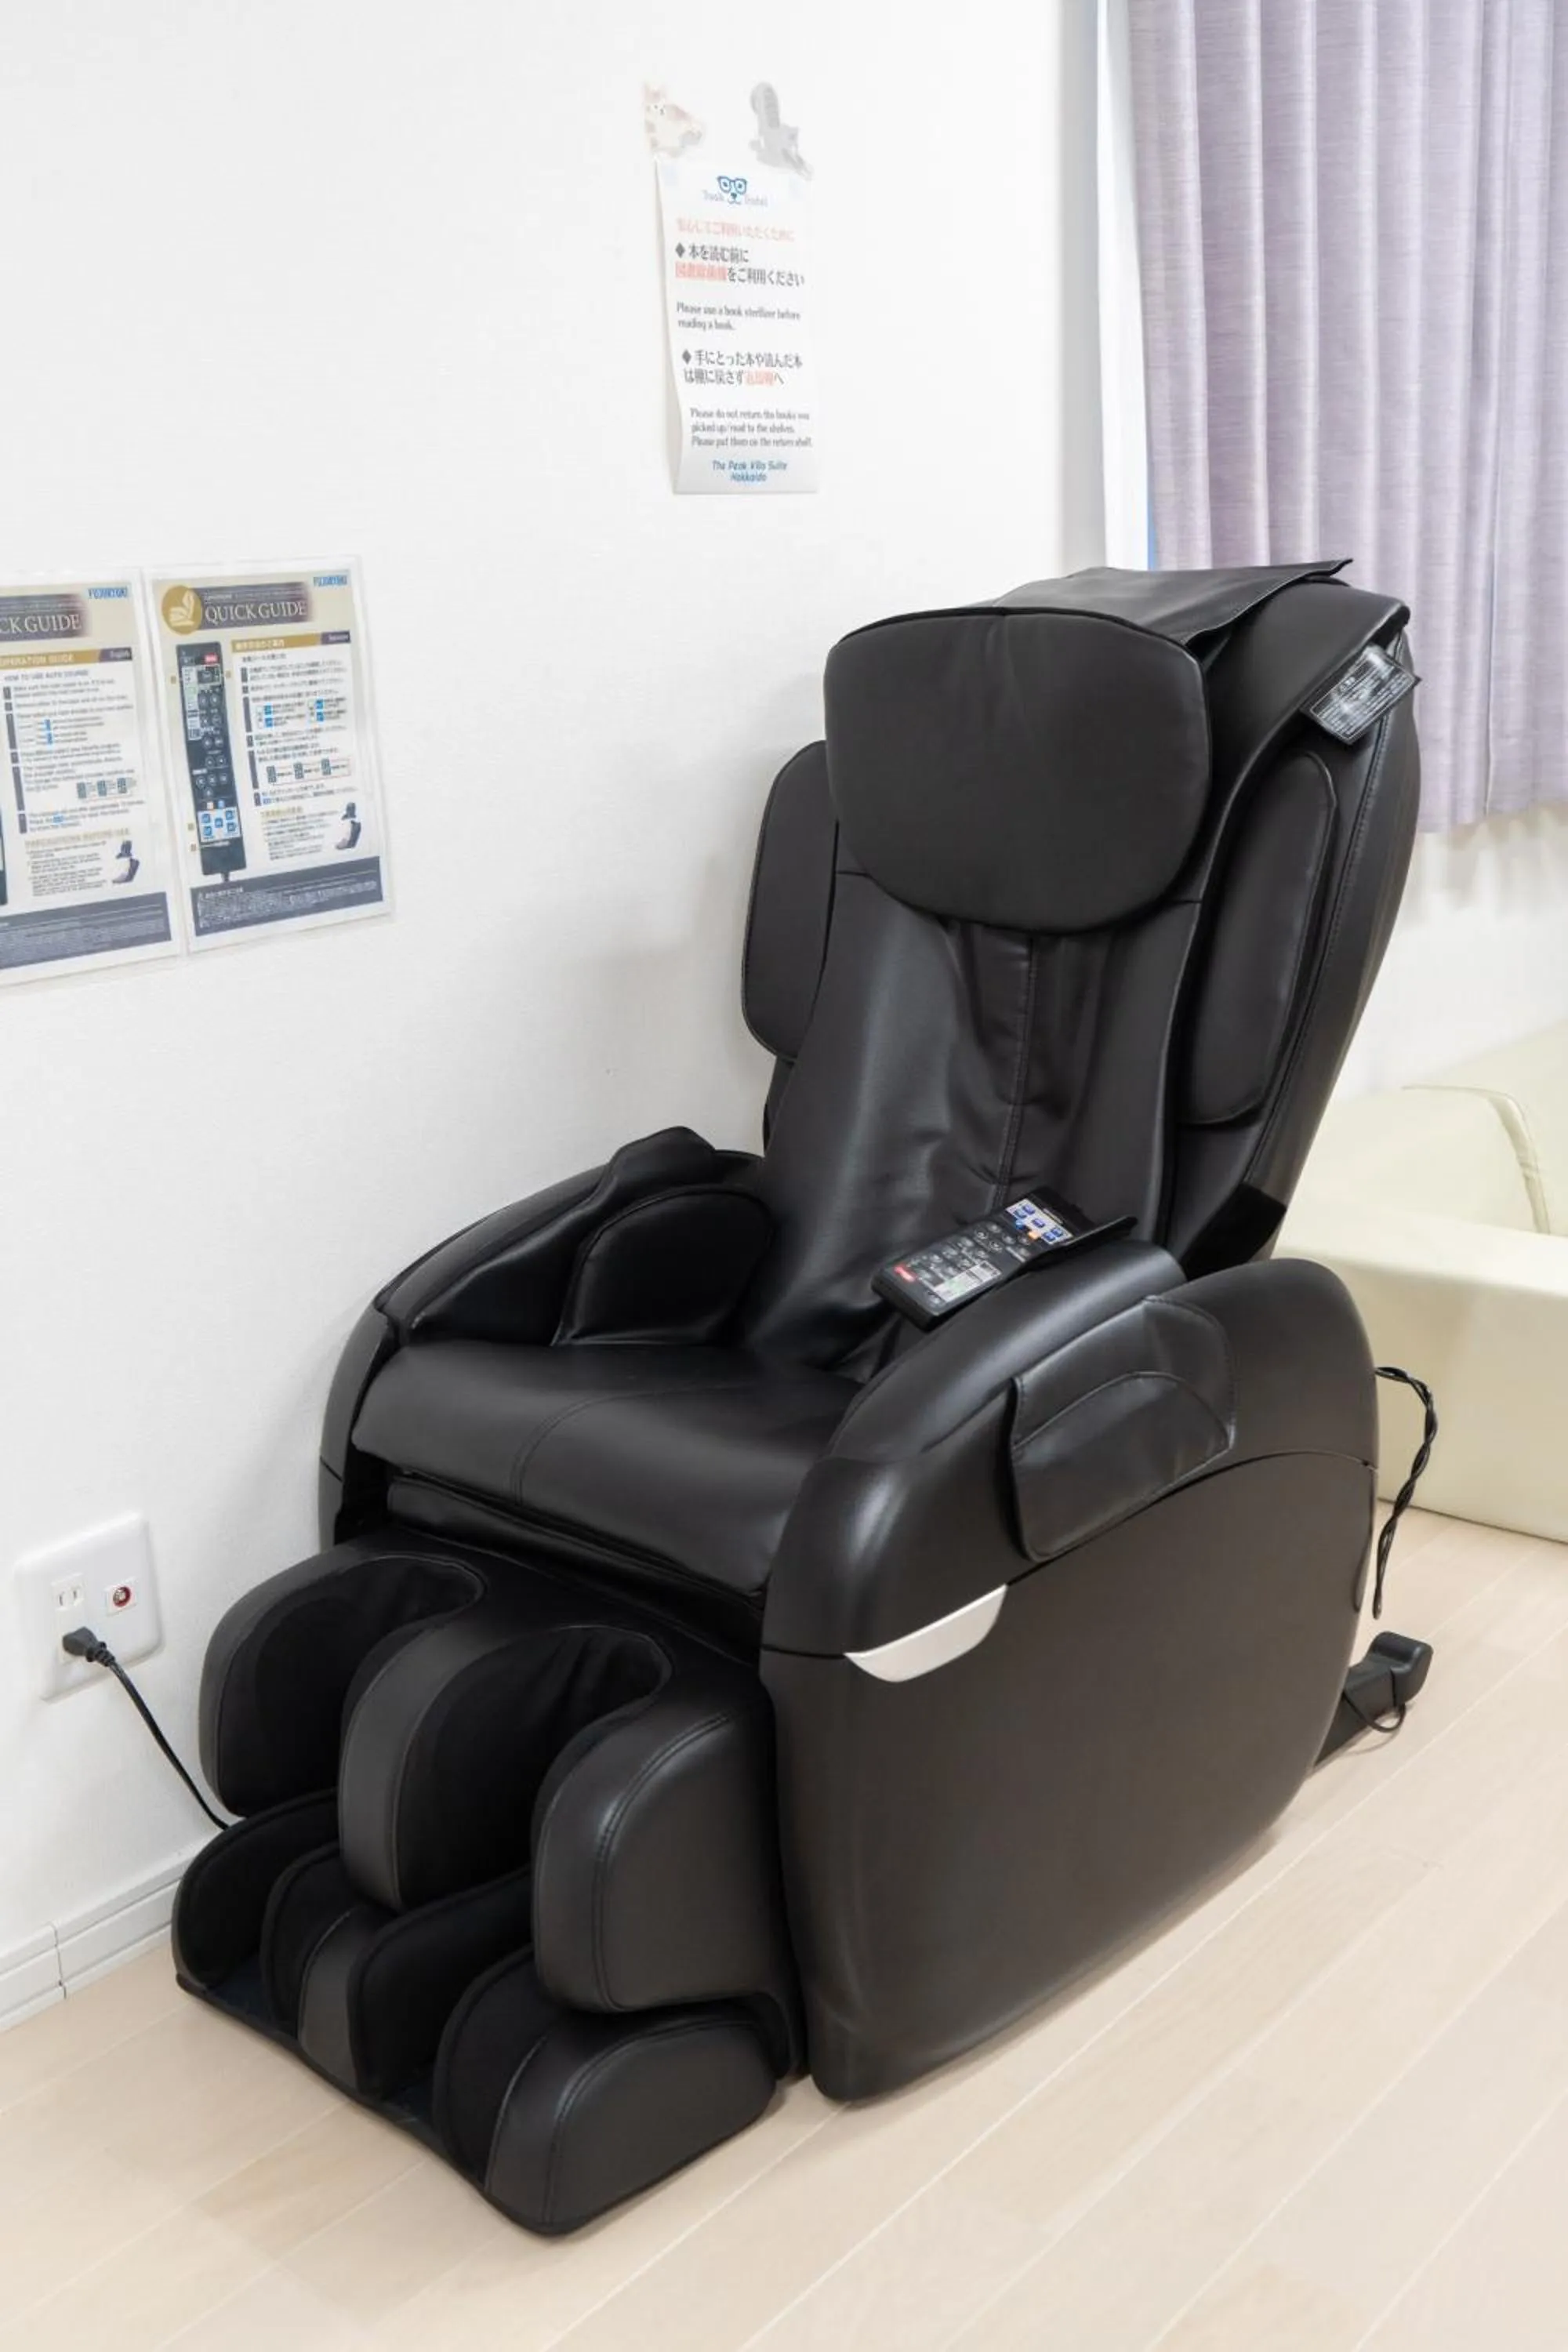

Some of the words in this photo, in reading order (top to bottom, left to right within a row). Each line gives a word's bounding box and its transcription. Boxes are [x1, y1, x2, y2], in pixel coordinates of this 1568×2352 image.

[688, 244, 749, 263] 本を読む前に
[677, 301, 701, 314] Please
[724, 305, 742, 317] book
[777, 308, 801, 321] before
[677, 318, 706, 332] reading
[690, 407, 713, 418] Please
[747, 423, 755, 433] to
[757, 423, 768, 434] the
[691, 435, 715, 447] Please
[716, 436, 728, 449] put
[730, 435, 749, 447] them
[760, 437, 771, 447] the
[772, 437, 794, 448] return
[205, 602, 256, 626] QUICK
[258, 601, 307, 619] GUIDE
[24, 614, 82, 633] GUIDE
